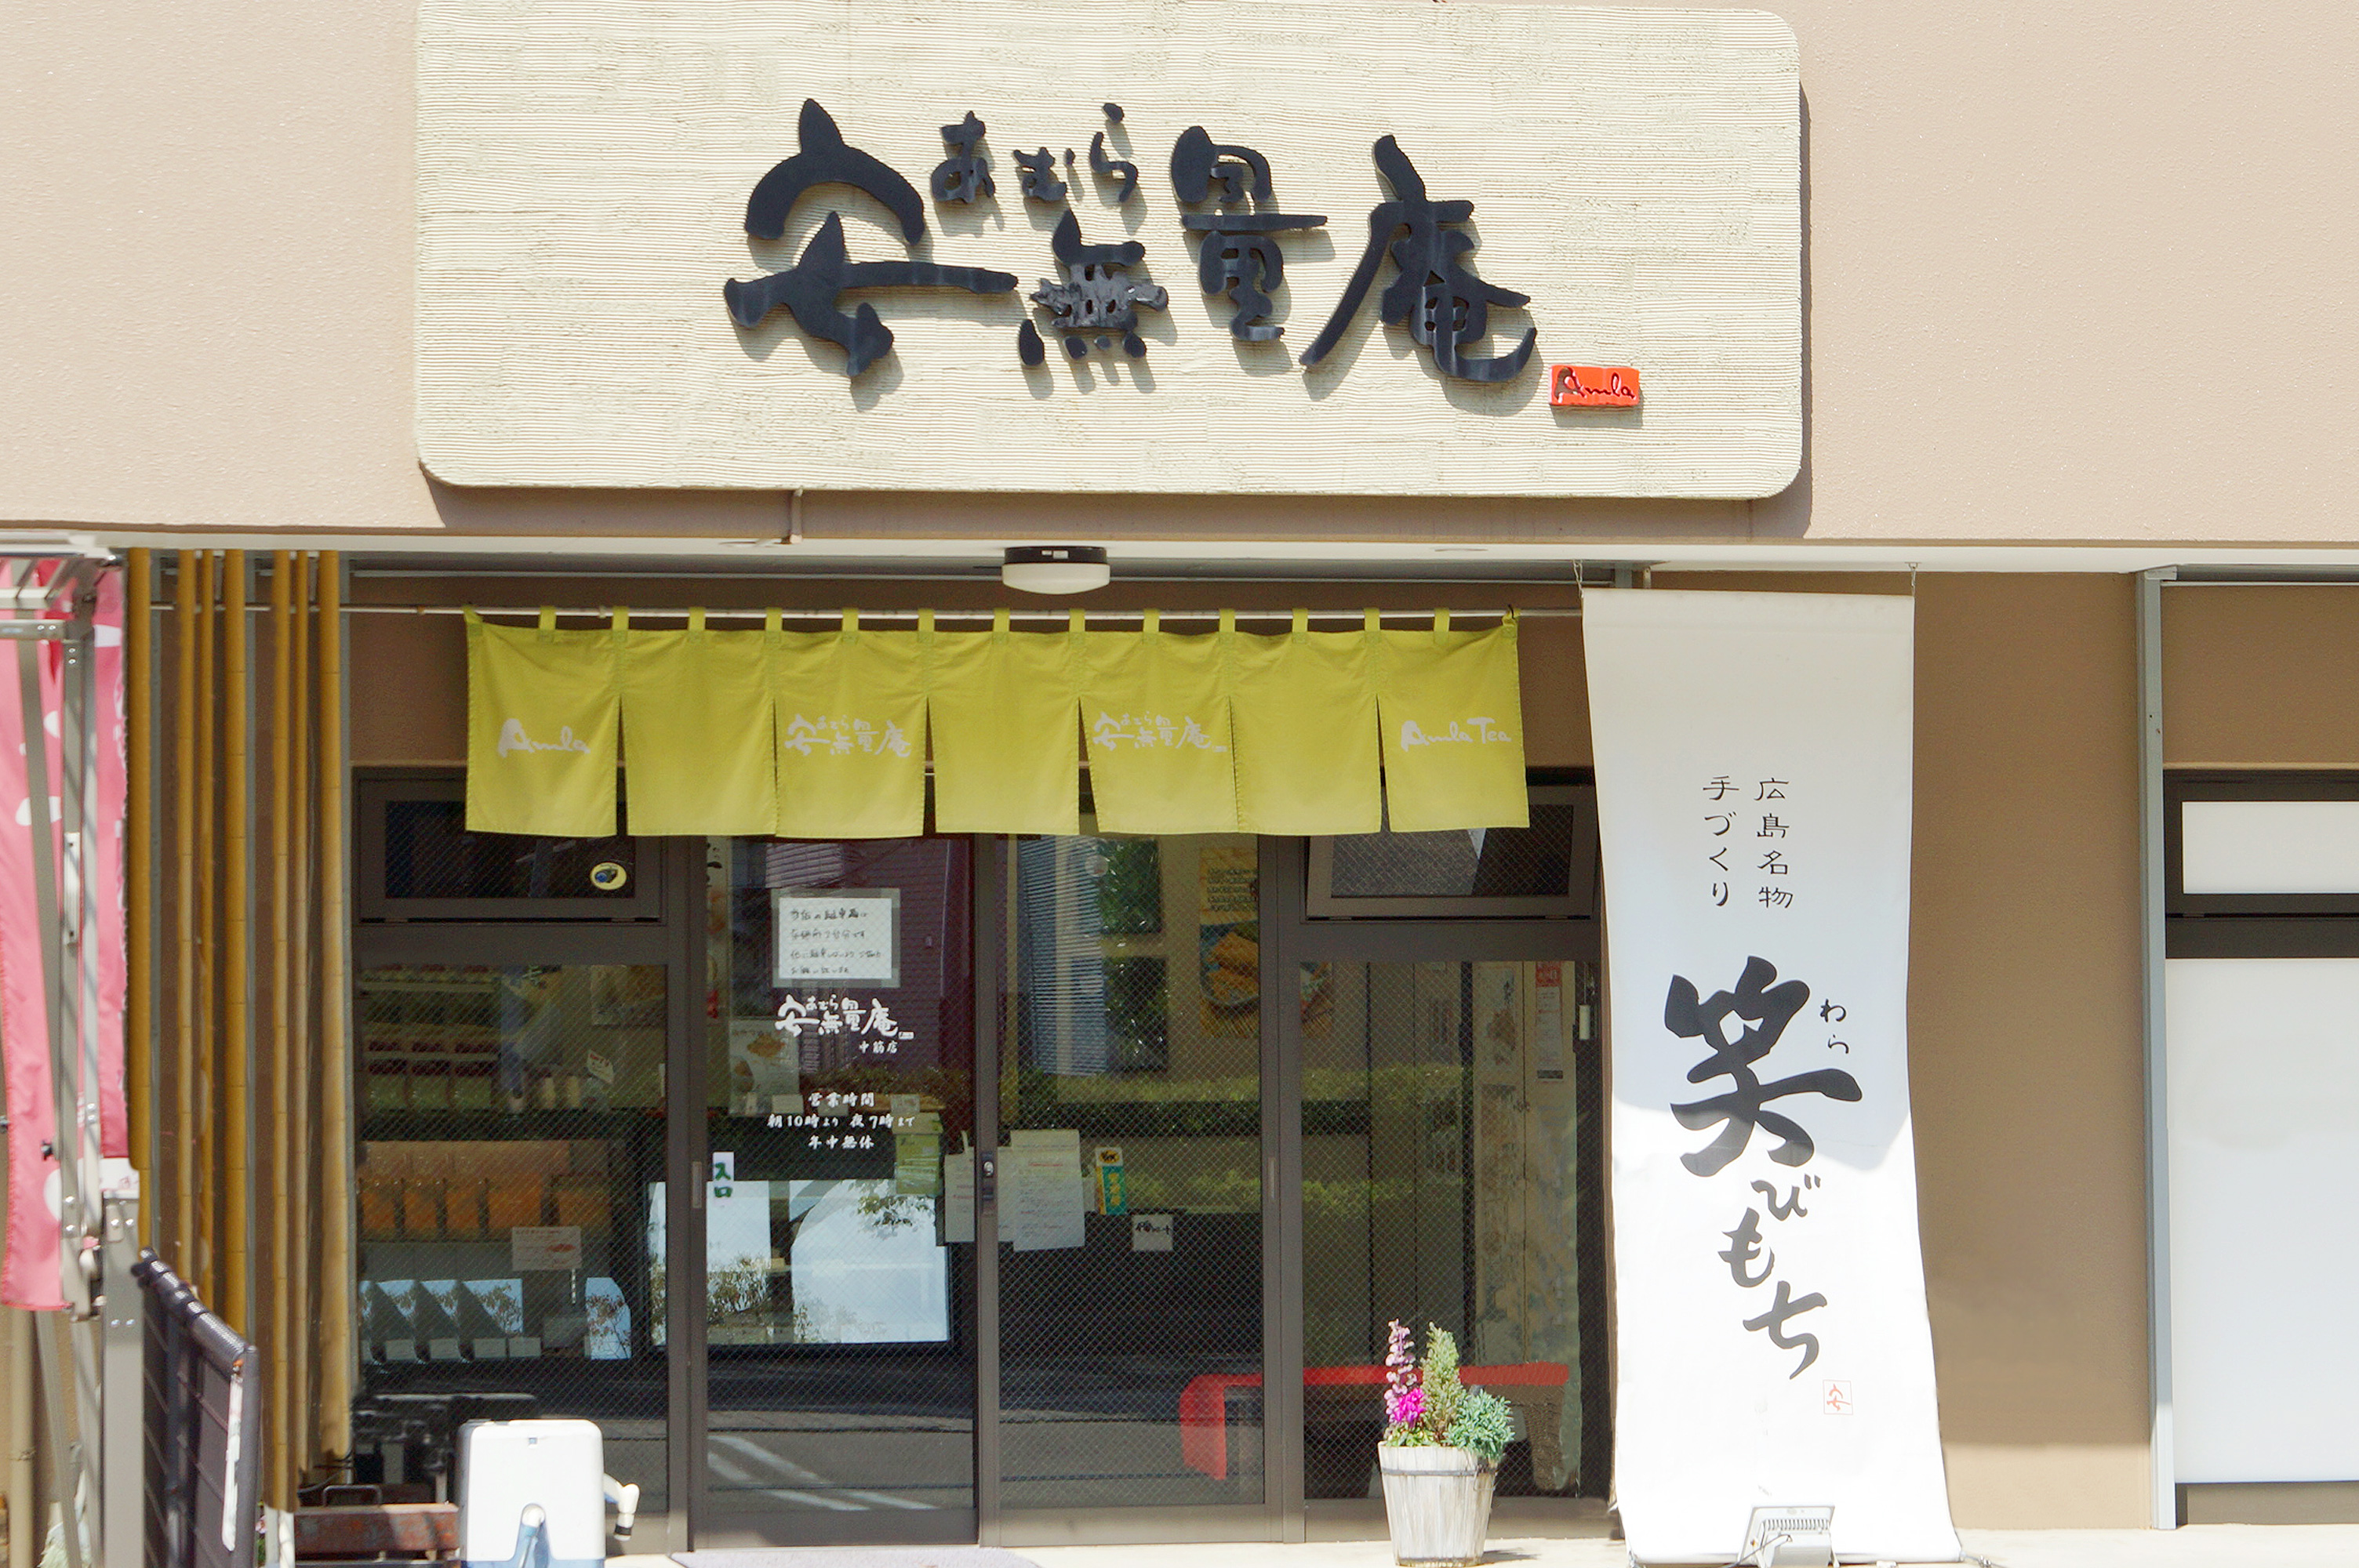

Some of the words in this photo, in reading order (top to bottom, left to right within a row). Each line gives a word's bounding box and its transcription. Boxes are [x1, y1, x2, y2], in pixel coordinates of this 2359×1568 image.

[1554, 366, 1635, 403] Amla
[498, 717, 591, 758] Amla
[1467, 717, 1513, 745] Tea
[1702, 775, 1740, 907] 手づくり
[1753, 776, 1794, 909] 広島名物
[1819, 998, 1850, 1054] わら
[808, 1091, 875, 1109] 営業時間
[808, 1134, 875, 1150] 年中無休
[714, 1162, 733, 1198] 入口
